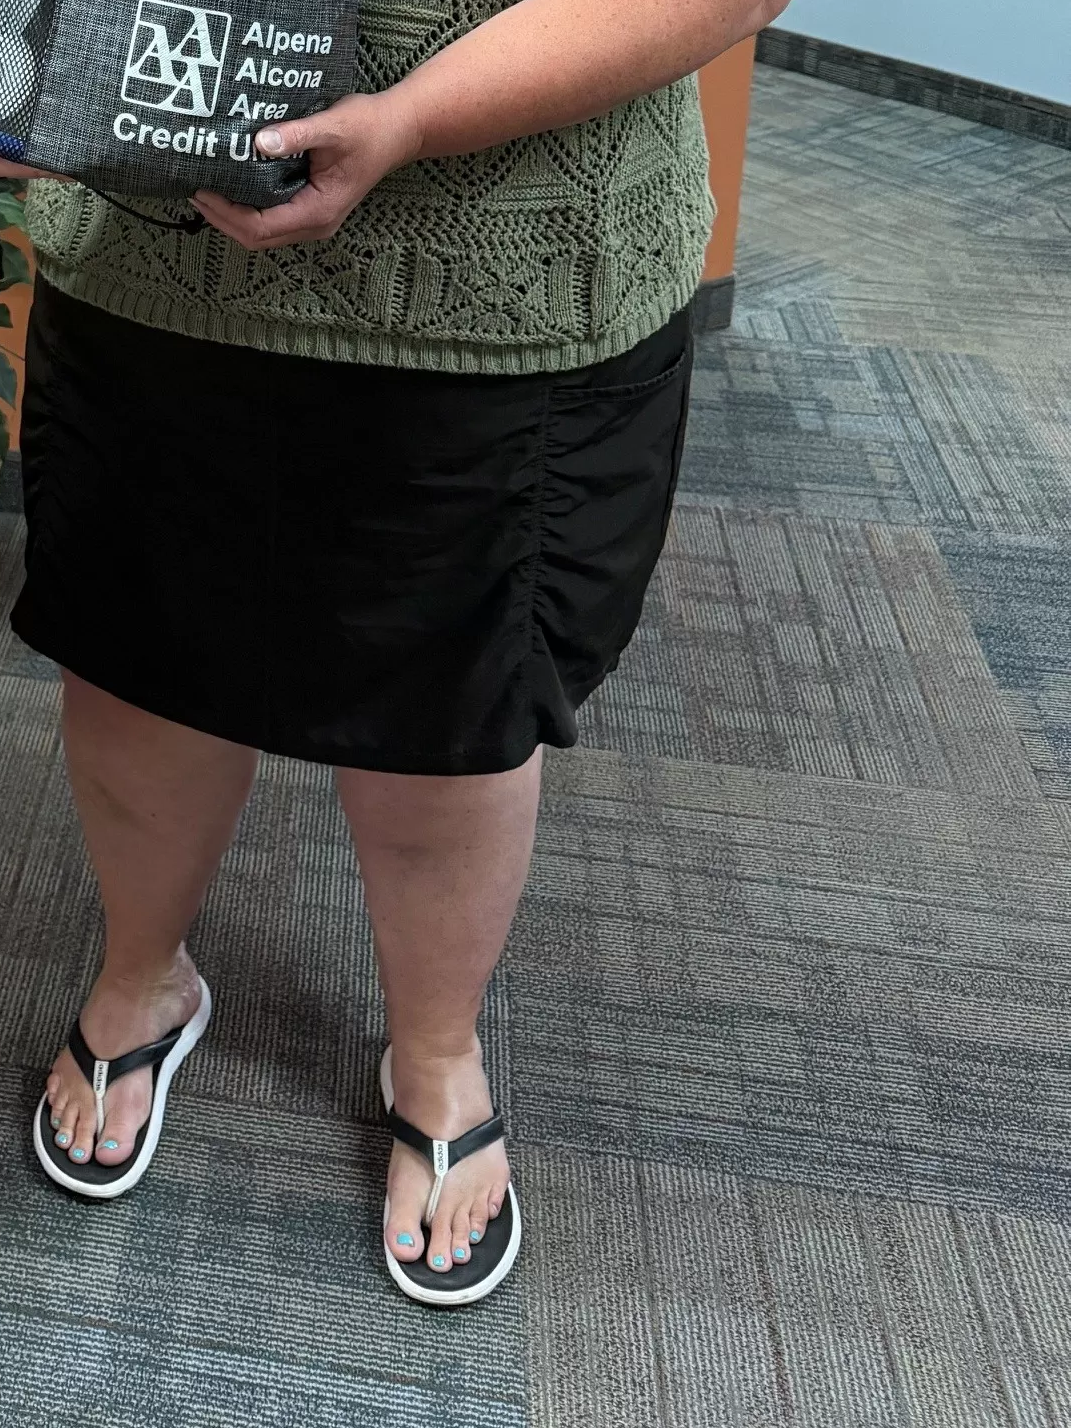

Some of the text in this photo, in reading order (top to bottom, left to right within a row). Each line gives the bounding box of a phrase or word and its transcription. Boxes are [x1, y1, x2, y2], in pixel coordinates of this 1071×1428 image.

[242, 22, 333, 55] Alpena
[235, 57, 323, 88] Alcona
[228, 93, 289, 120] Area
[113, 113, 218, 158] Credit
